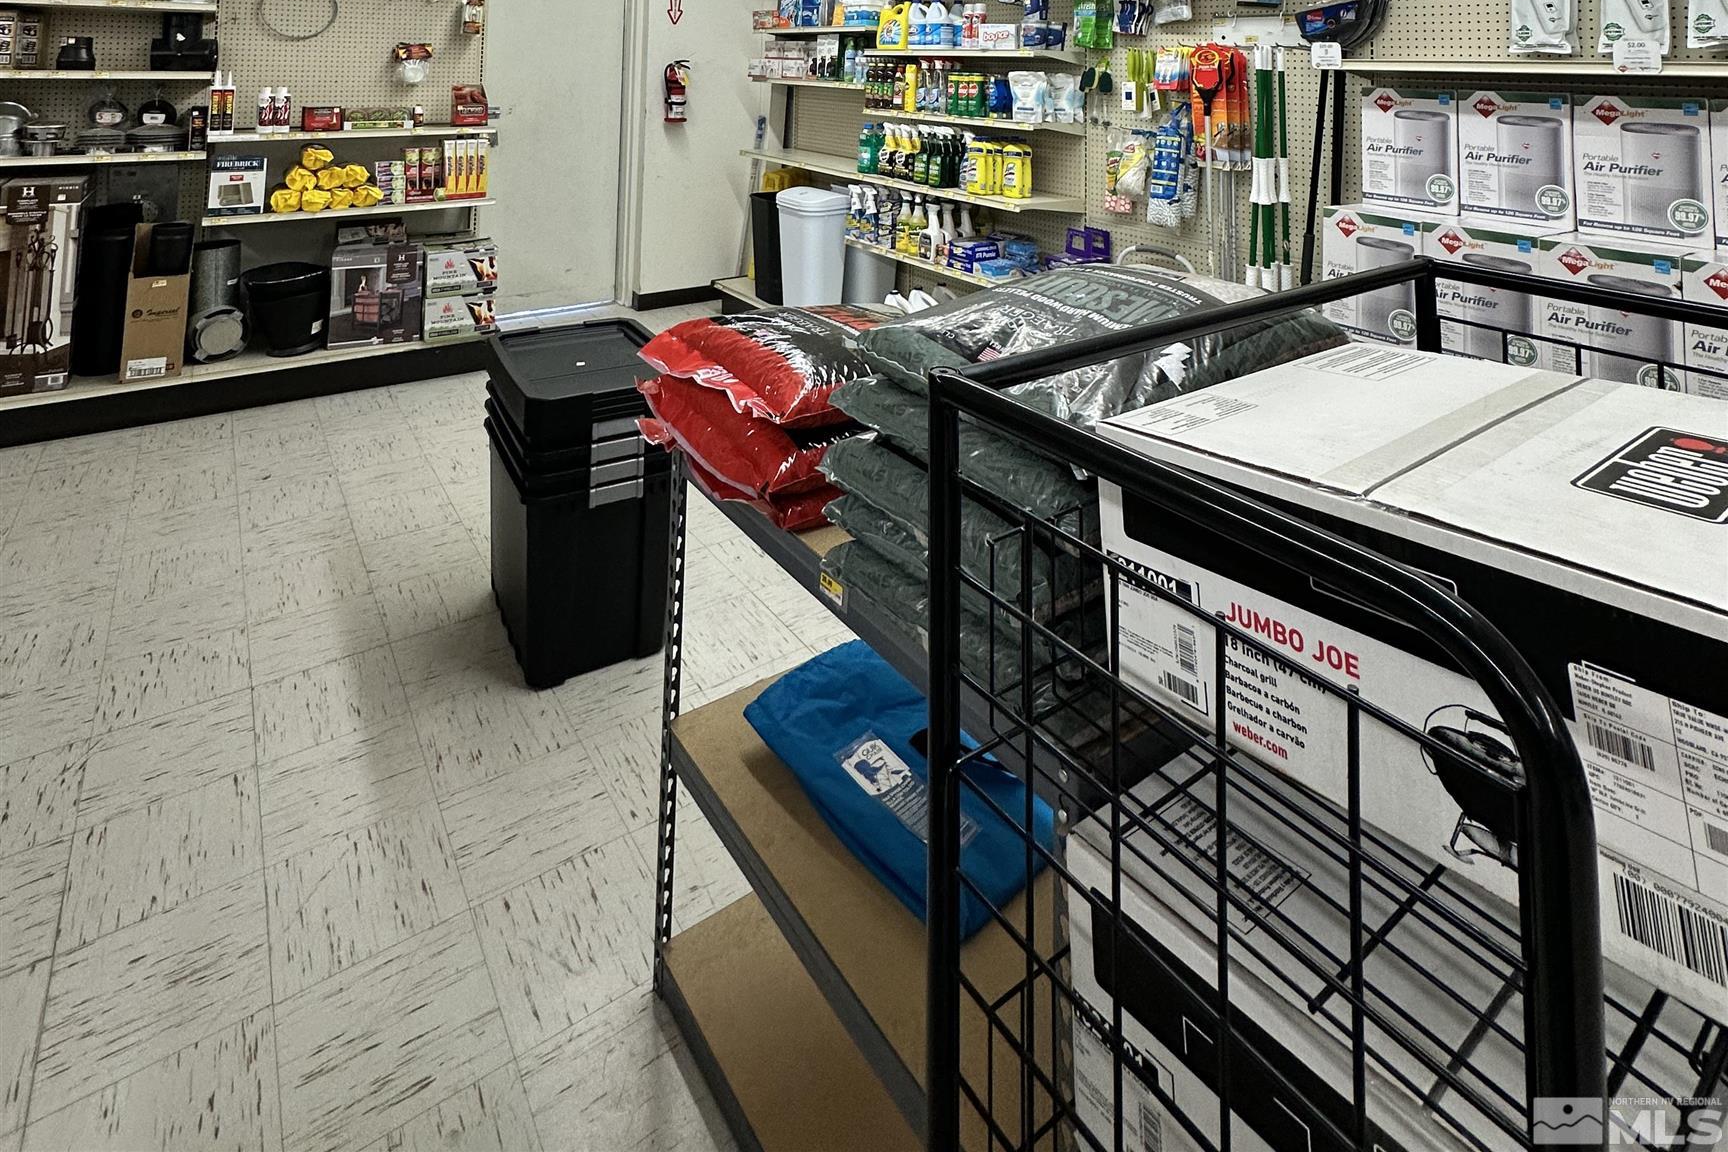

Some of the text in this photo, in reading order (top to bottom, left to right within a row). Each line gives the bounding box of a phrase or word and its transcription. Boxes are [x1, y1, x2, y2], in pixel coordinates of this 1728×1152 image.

[983, 30, 1009, 42] bounce
[1376, 98, 1413, 107] MegaLight
[1476, 102, 1517, 112] MegaLight
[1595, 108, 1645, 117] MegaLight
[1366, 136, 1392, 144] Portable
[1367, 143, 1424, 156] Air Purifier
[1465, 151, 1532, 165] Air Purifier
[1583, 153, 1619, 162] Portable
[1584, 161, 1664, 176] Air Purifier
[1674, 211, 1705, 223] 99.97%
[1338, 221, 1375, 233] MegaLight
[1441, 237, 1484, 249] MegaLight
[1327, 261, 1354, 270] Portable
[1561, 255, 1615, 270] MegaLight
[1156, 282, 1203, 305] TRUSTED
[1451, 291, 1499, 308] Purifier
[1032, 294, 1090, 315] HARDWOOD
[1547, 303, 1585, 315] Portable
[999, 302, 1078, 337] TRAEGER
[1087, 310, 1132, 330] EMIUM
[1547, 312, 1632, 336] Air Purifier
[1692, 330, 1728, 342] Portab
[1692, 341, 1720, 354] Air
[1609, 446, 1728, 508] weber
[1225, 602, 1304, 653] JUMBO
[1312, 640, 1360, 680] JOE
[1225, 655, 1278, 688] Charcoal grill
[1225, 670, 1262, 695] Barbacoa
[1270, 694, 1301, 715] carbón
[1226, 685, 1263, 711] Barbecue
[1272, 709, 1308, 734] charbon
[1672, 701, 1690, 713] Ship
[1227, 700, 1267, 728] Grelhador
[1276, 727, 1306, 749] carvão
[1232, 721, 1289, 760] weber.com
